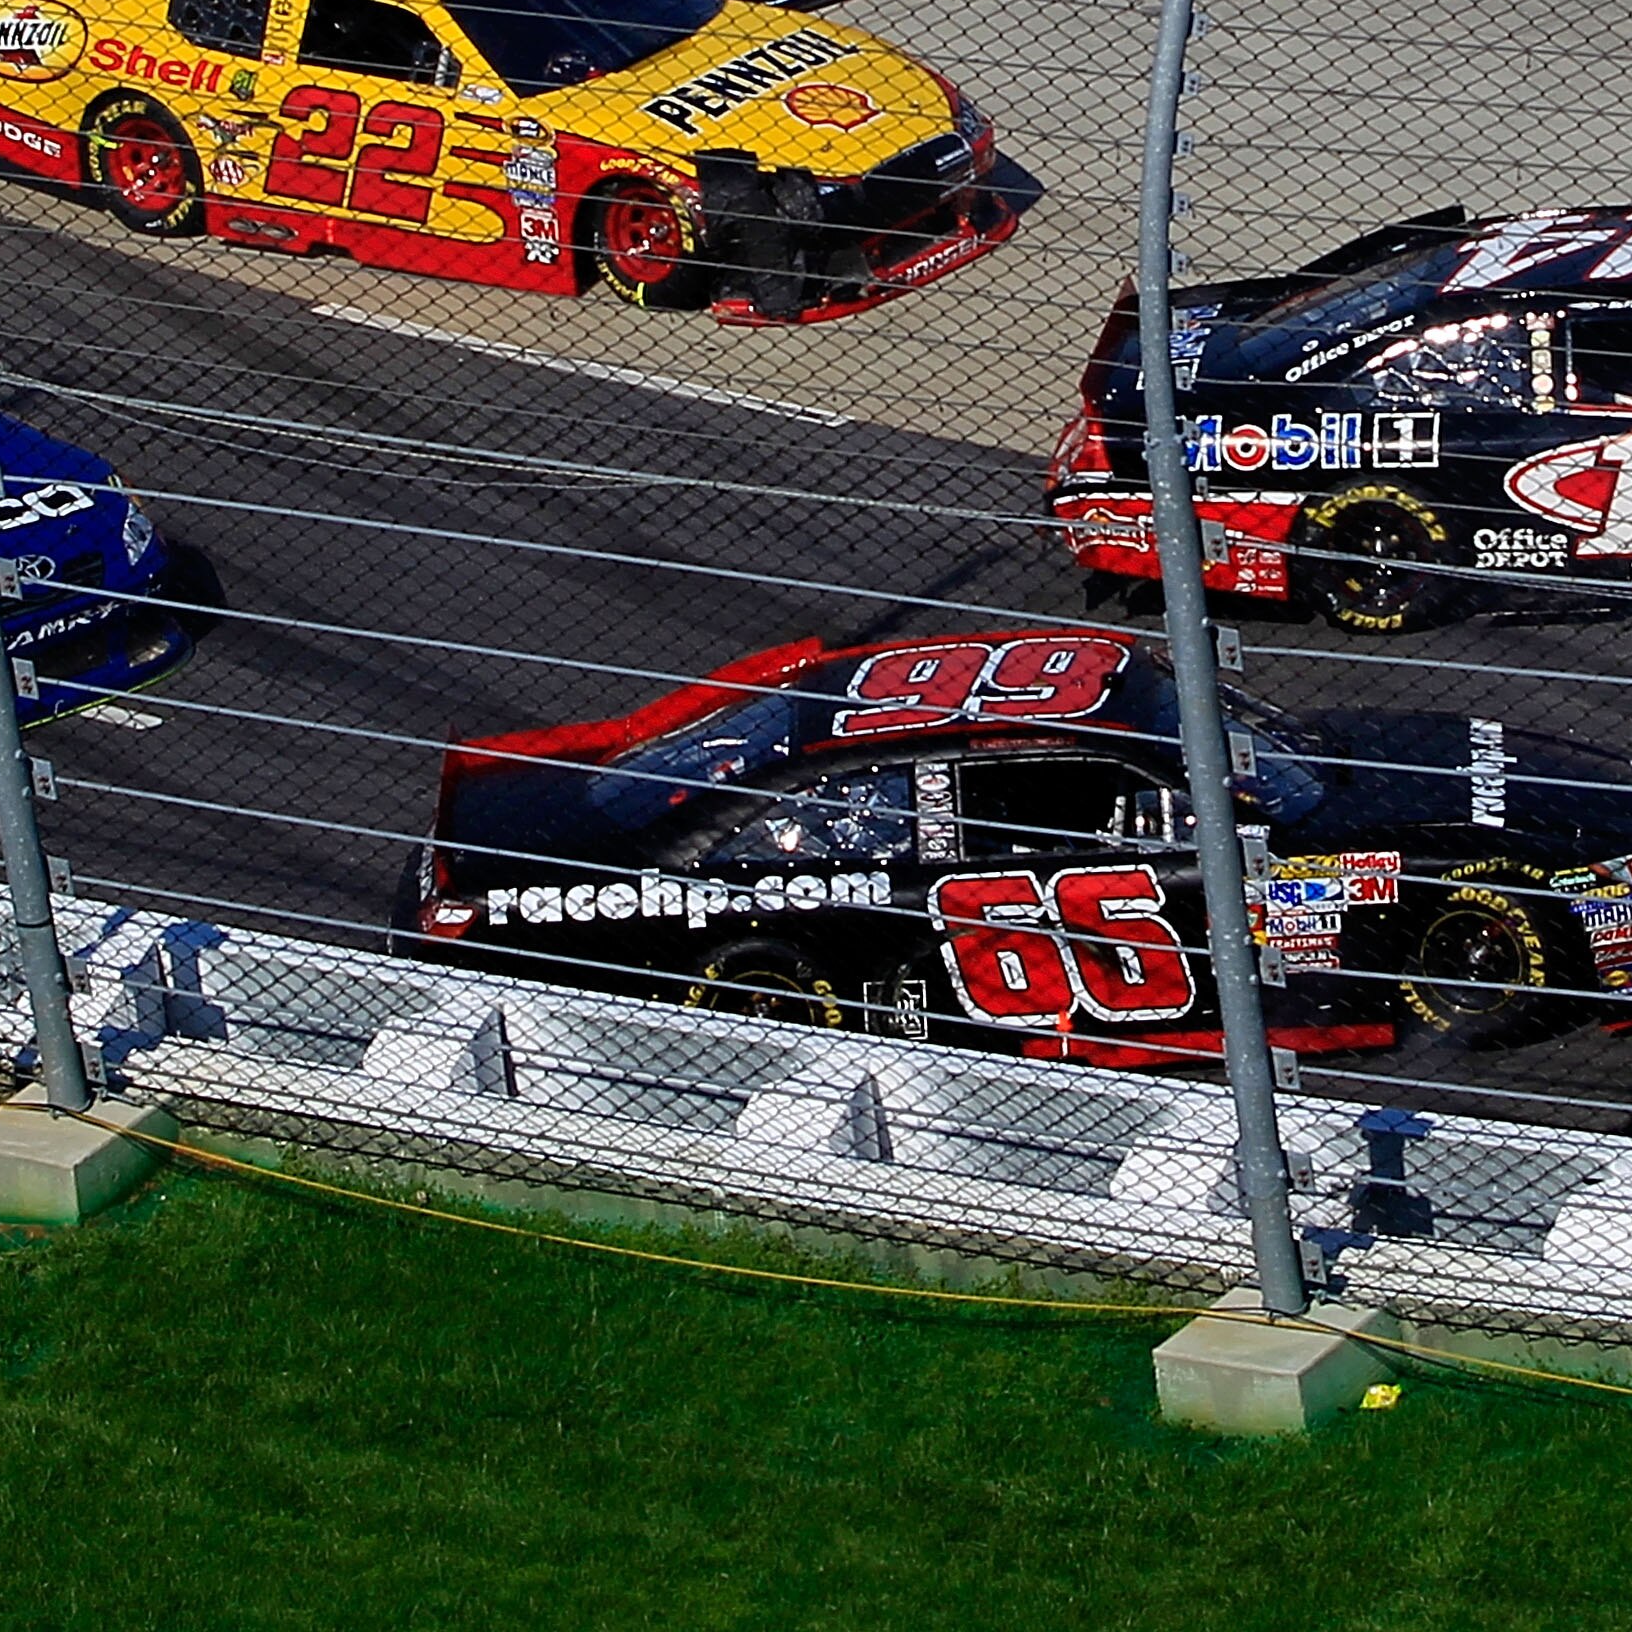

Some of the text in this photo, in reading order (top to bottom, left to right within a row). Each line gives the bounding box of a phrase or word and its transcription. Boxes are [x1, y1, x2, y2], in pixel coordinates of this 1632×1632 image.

[89, 37, 223, 95] Shell
[640, 28, 864, 139] PENNZOIL
[264, 85, 444, 226] 22
[524, 216, 557, 239] 3M
[1285, 341, 1350, 383] Office
[1176, 413, 1416, 471] Mobil 1
[1474, 529, 1568, 551] Office
[1475, 551, 1568, 568] DEPOT
[1342, 853, 1399, 870] Holley
[487, 867, 892, 929] racehp.com
[1268, 880, 1302, 907] USG
[1348, 877, 1395, 902] 3M
[1268, 917, 1317, 933] Mobil
[927, 864, 1195, 1026] 66
